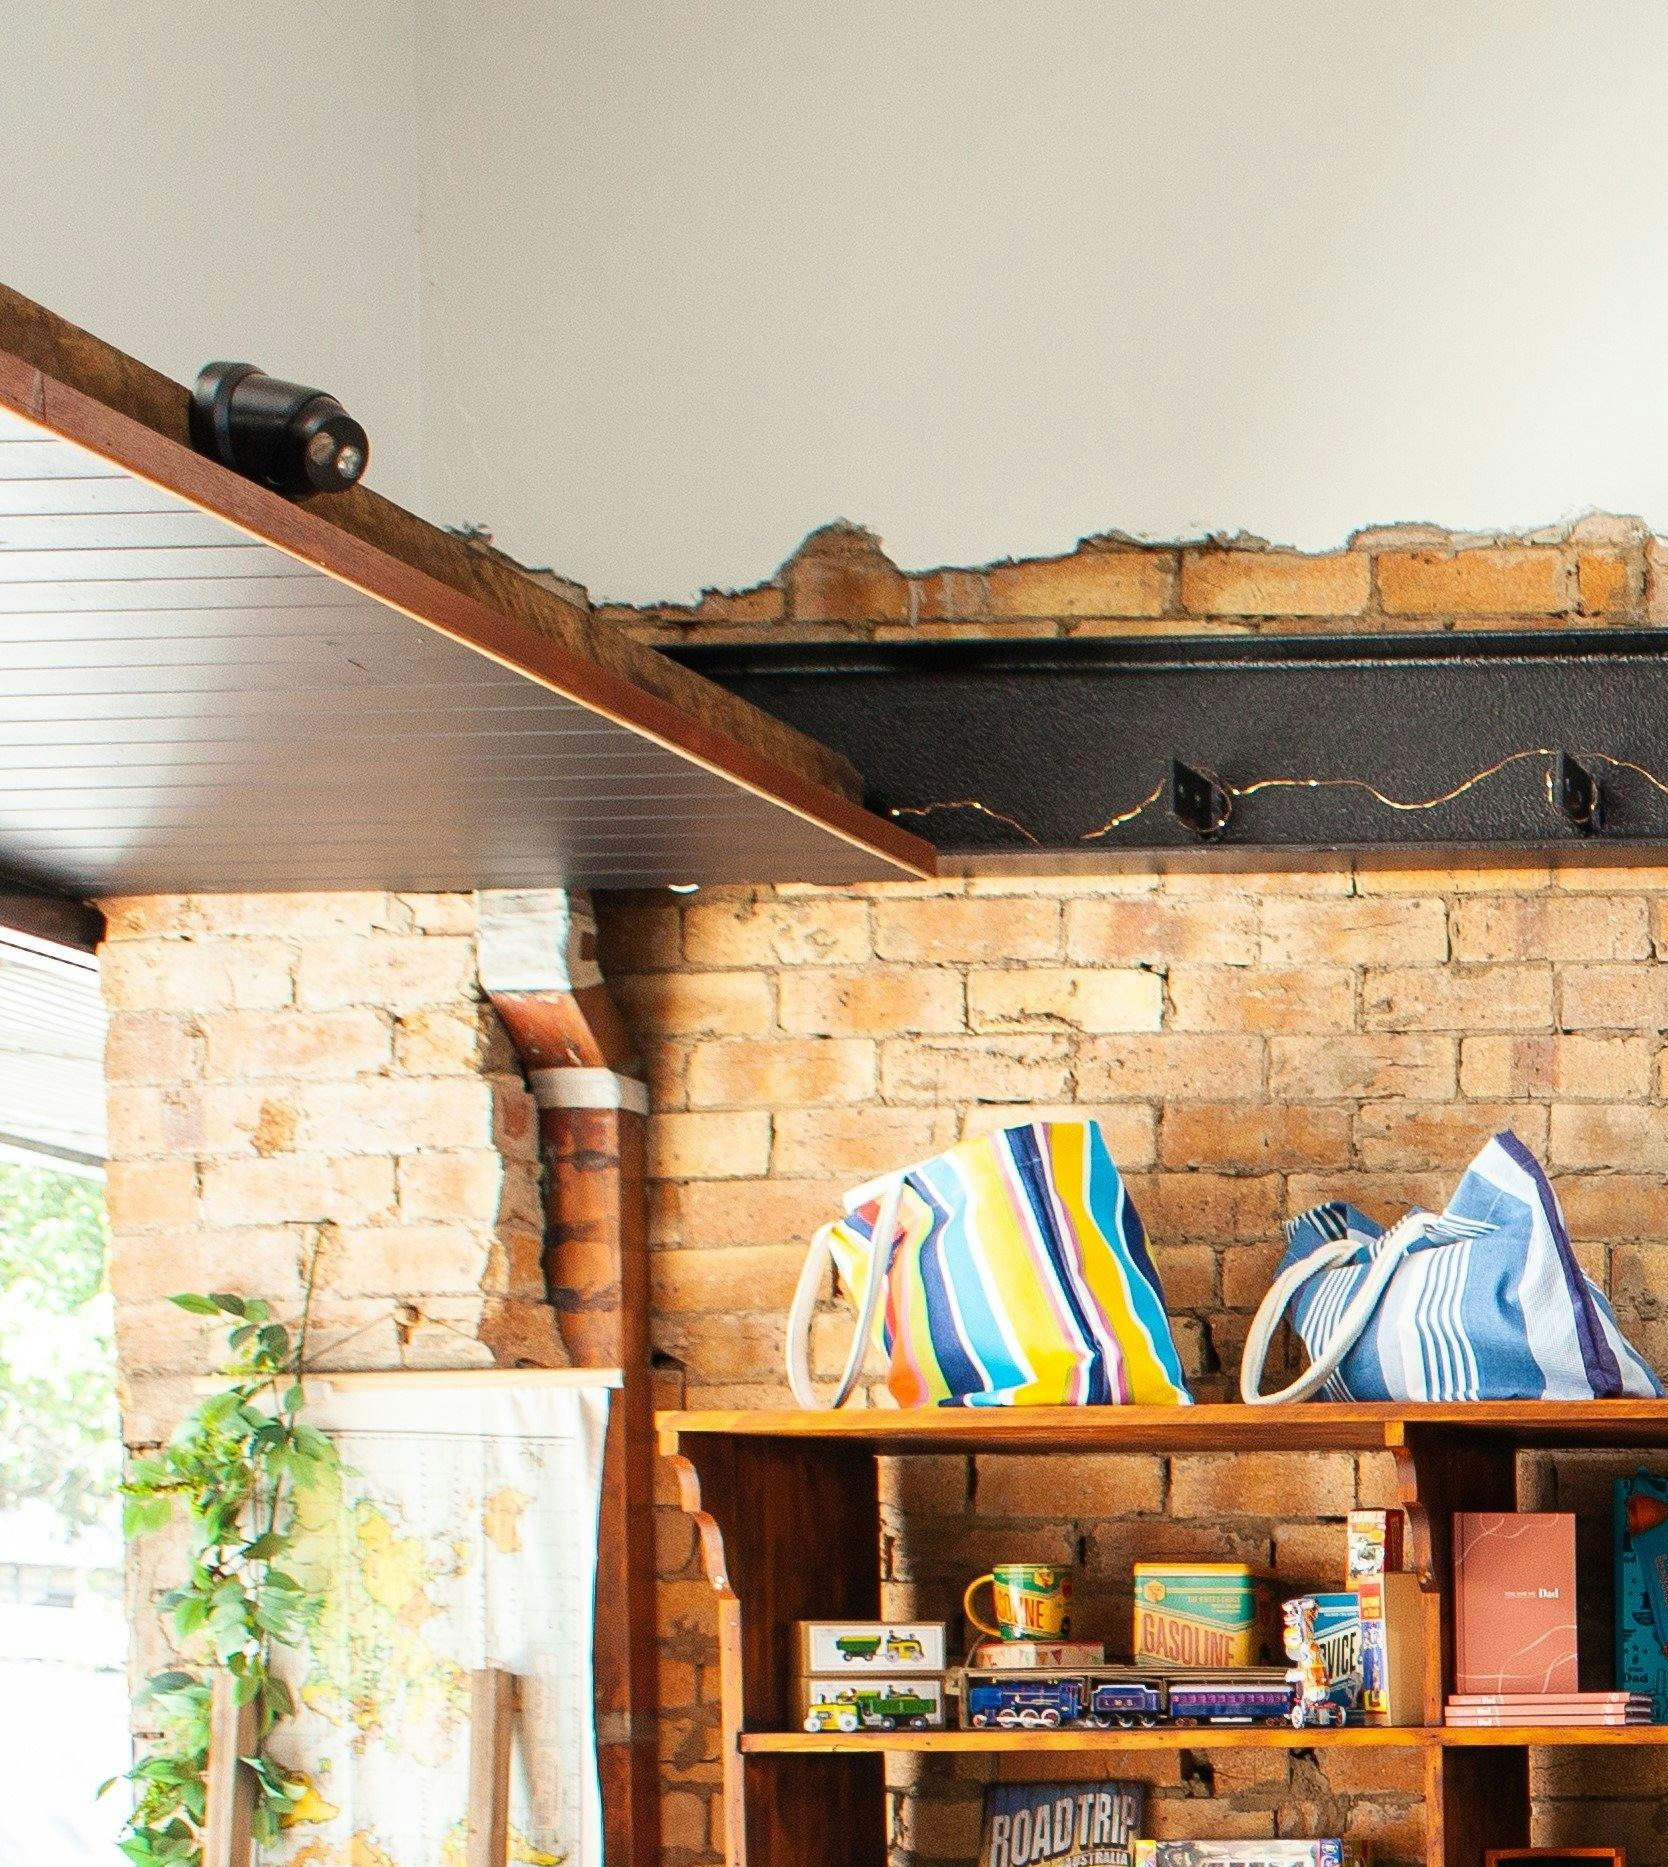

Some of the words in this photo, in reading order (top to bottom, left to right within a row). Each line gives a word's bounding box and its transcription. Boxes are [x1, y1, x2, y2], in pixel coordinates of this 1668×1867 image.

[1538, 1588, 1560, 1599] Dad
[1143, 1613, 1235, 1667] GASOLINE
[1074, 1793, 1136, 1850] TRIP
